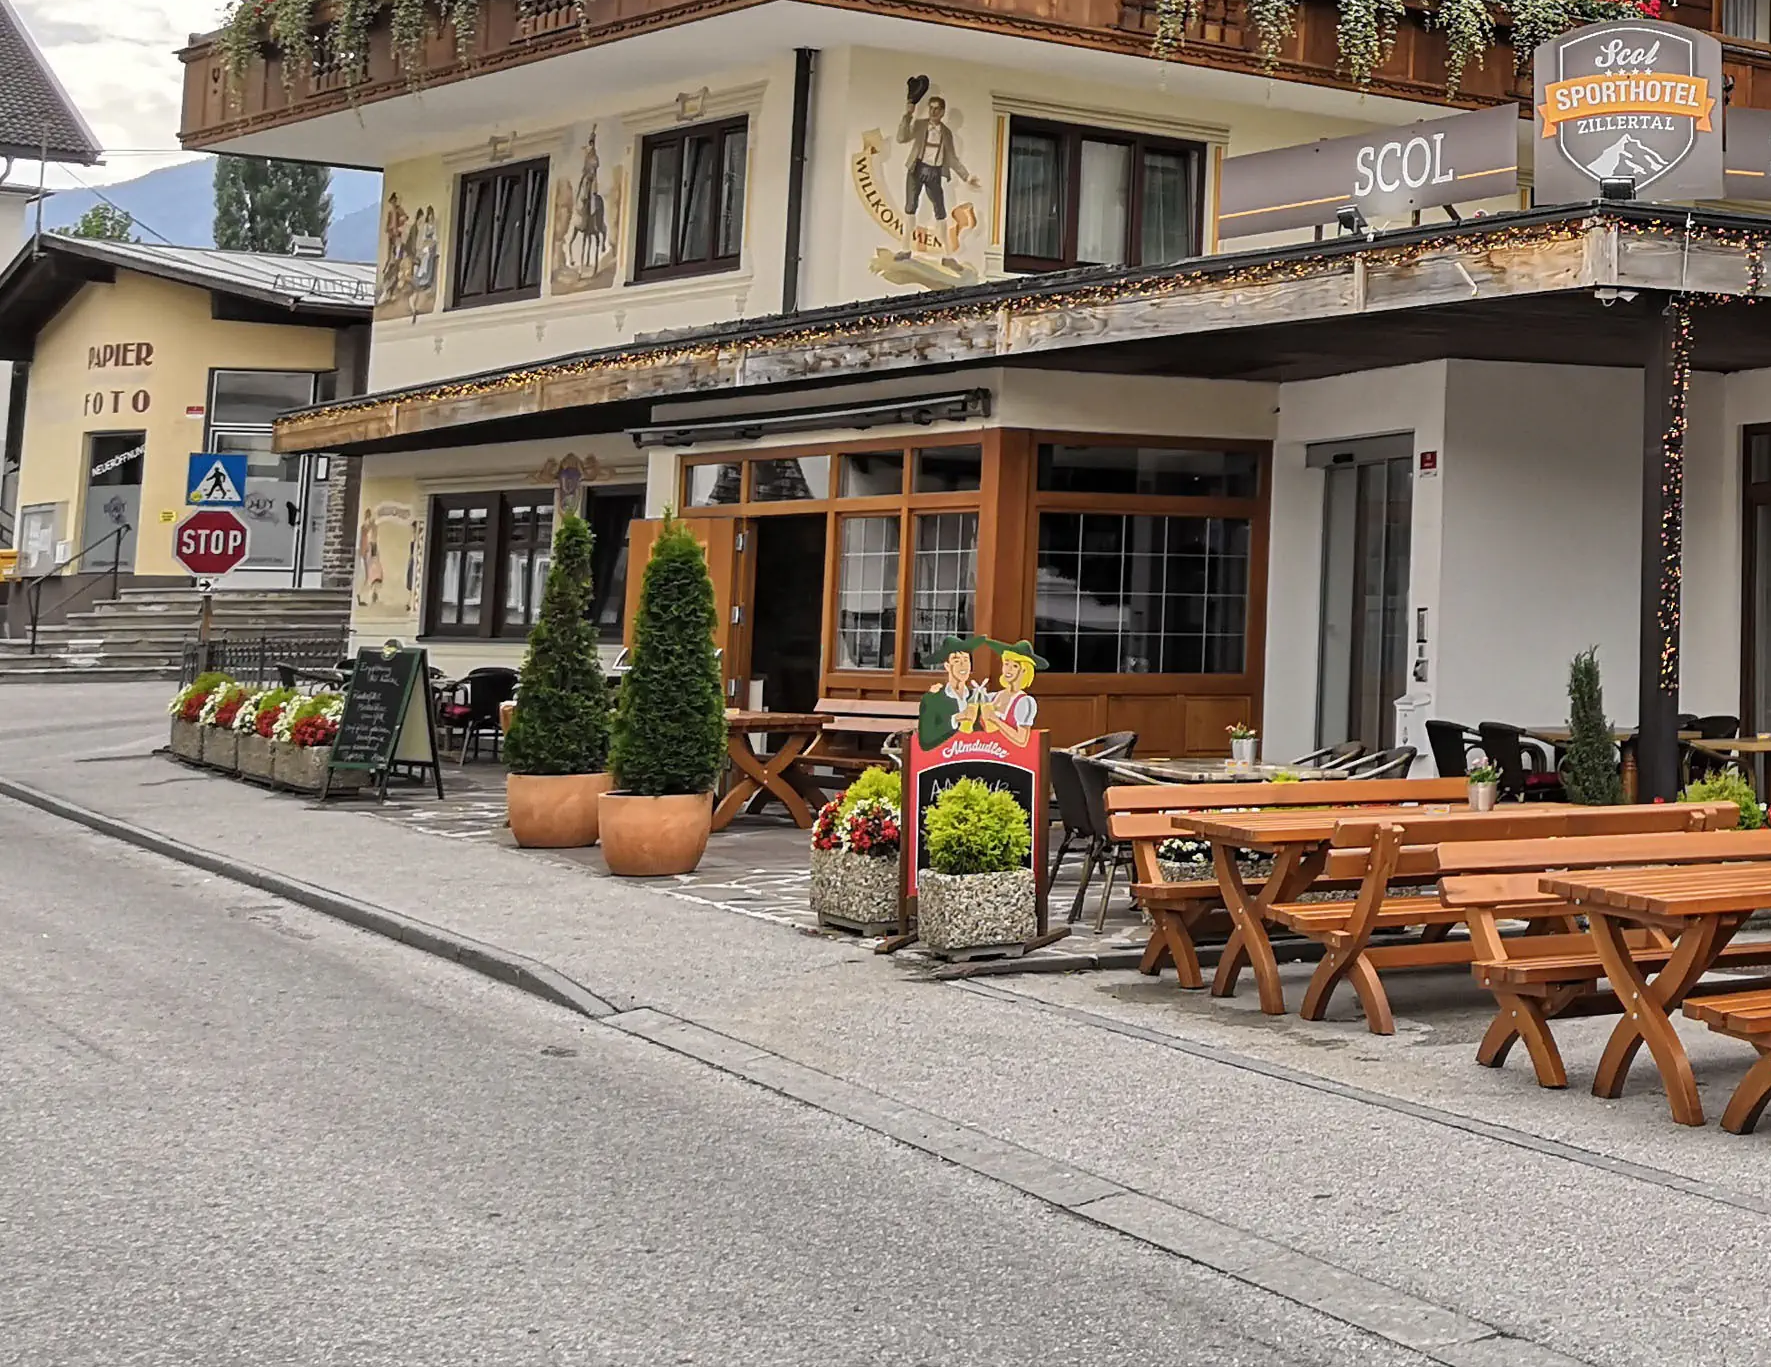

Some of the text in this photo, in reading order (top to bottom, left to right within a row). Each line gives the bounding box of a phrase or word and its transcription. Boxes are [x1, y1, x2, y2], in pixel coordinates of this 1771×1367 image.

[1595, 39, 1660, 67] Scol
[1555, 80, 1699, 110] SPORTHOTEL
[1577, 115, 1675, 134] ZILLERTAL
[1354, 133, 1453, 196] SCOL
[88, 342, 154, 370] PAPIER
[84, 389, 151, 416] FOTO
[181, 529, 242, 556] STOP
[942, 739, 1009, 758] Almdudler
